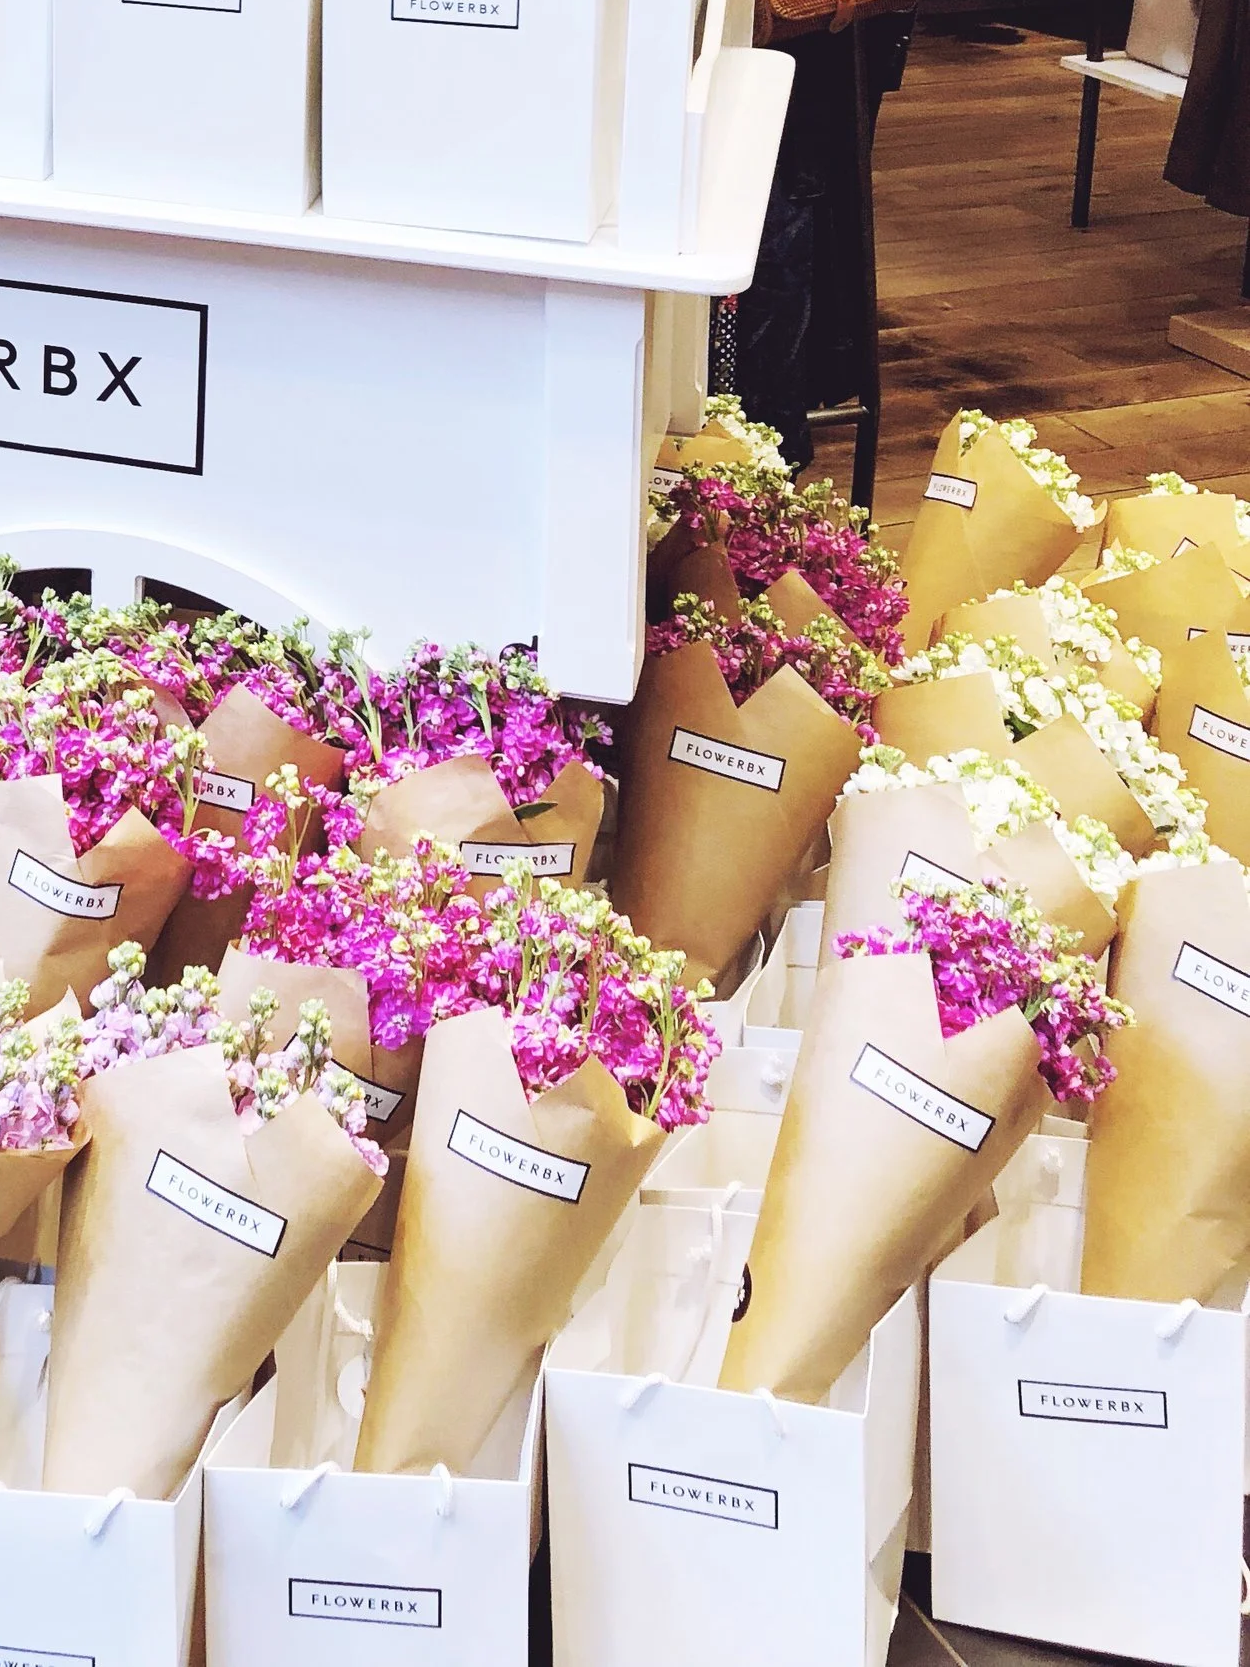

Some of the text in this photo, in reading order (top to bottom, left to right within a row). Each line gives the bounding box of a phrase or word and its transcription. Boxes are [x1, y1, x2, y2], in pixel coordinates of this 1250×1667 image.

[1201, 721, 1250, 749] FLOWE
[685, 742, 767, 777] FLOWERBX
[25, 870, 106, 910] FLOWERBX
[1193, 963, 1250, 1003] FLOWE
[873, 1067, 970, 1133] FLOWERBX
[468, 1134, 566, 1186] FLOWERBX
[169, 1173, 262, 1235] FLOWERBX
[1040, 1394, 1145, 1414] FLOWERBX
[650, 1480, 756, 1512] FLOWERBX
[311, 1593, 418, 1615] FLOWERBX
